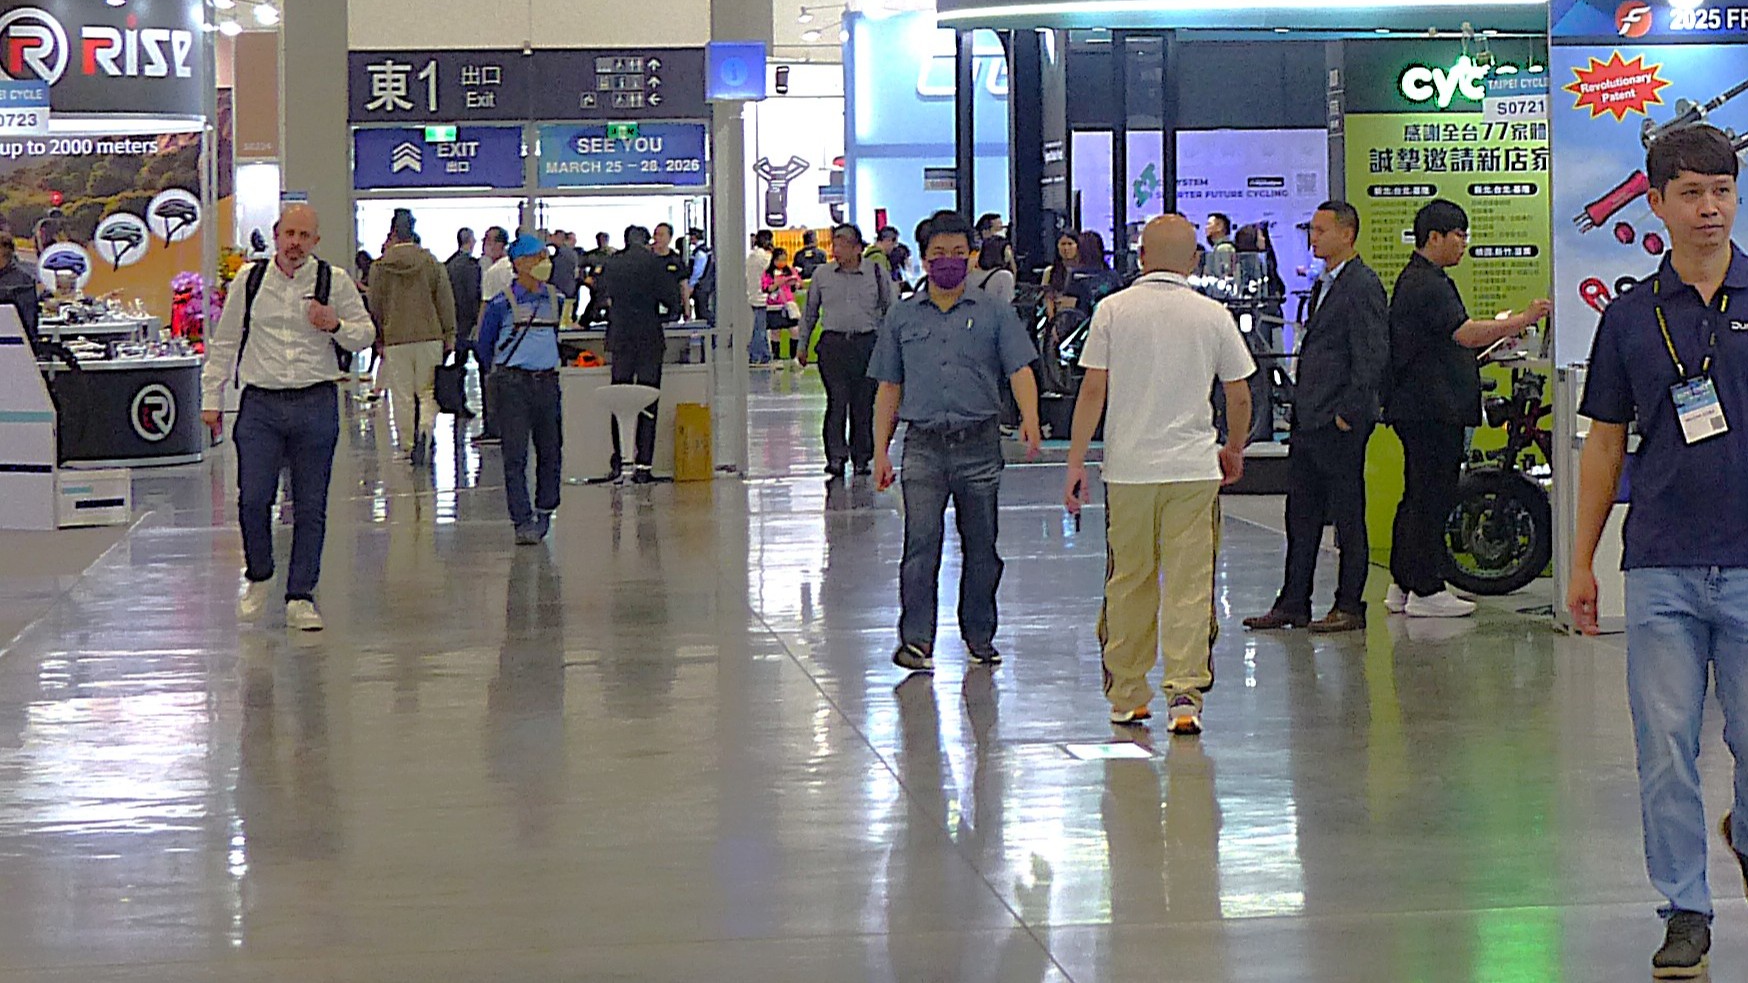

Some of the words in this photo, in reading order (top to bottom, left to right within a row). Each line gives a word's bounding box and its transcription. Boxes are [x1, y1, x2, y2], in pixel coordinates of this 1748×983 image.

[1669, 7, 1721, 30] 2025
[461, 65, 501, 85] 出口
[1580, 73, 1652, 93] Revolutionary
[1487, 79, 1517, 90] TAIPEI
[10, 88, 43, 101] CYCLE
[466, 92, 496, 109] Exit
[1602, 88, 1636, 103] Patent
[1497, 100, 1545, 116] S0721
[0, 142, 23, 159] up
[27, 140, 46, 156] to
[49, 139, 92, 155] 2000
[97, 139, 158, 155] meters
[437, 142, 479, 158] EXIT
[577, 138, 616, 154] SEE
[621, 137, 663, 153] YOU
[446, 161, 470, 173] 出口
[546, 160, 601, 174] MARCH
[605, 160, 622, 174] 25
[666, 159, 700, 172] 2026
[1205, 189, 1243, 198] FUTURE
